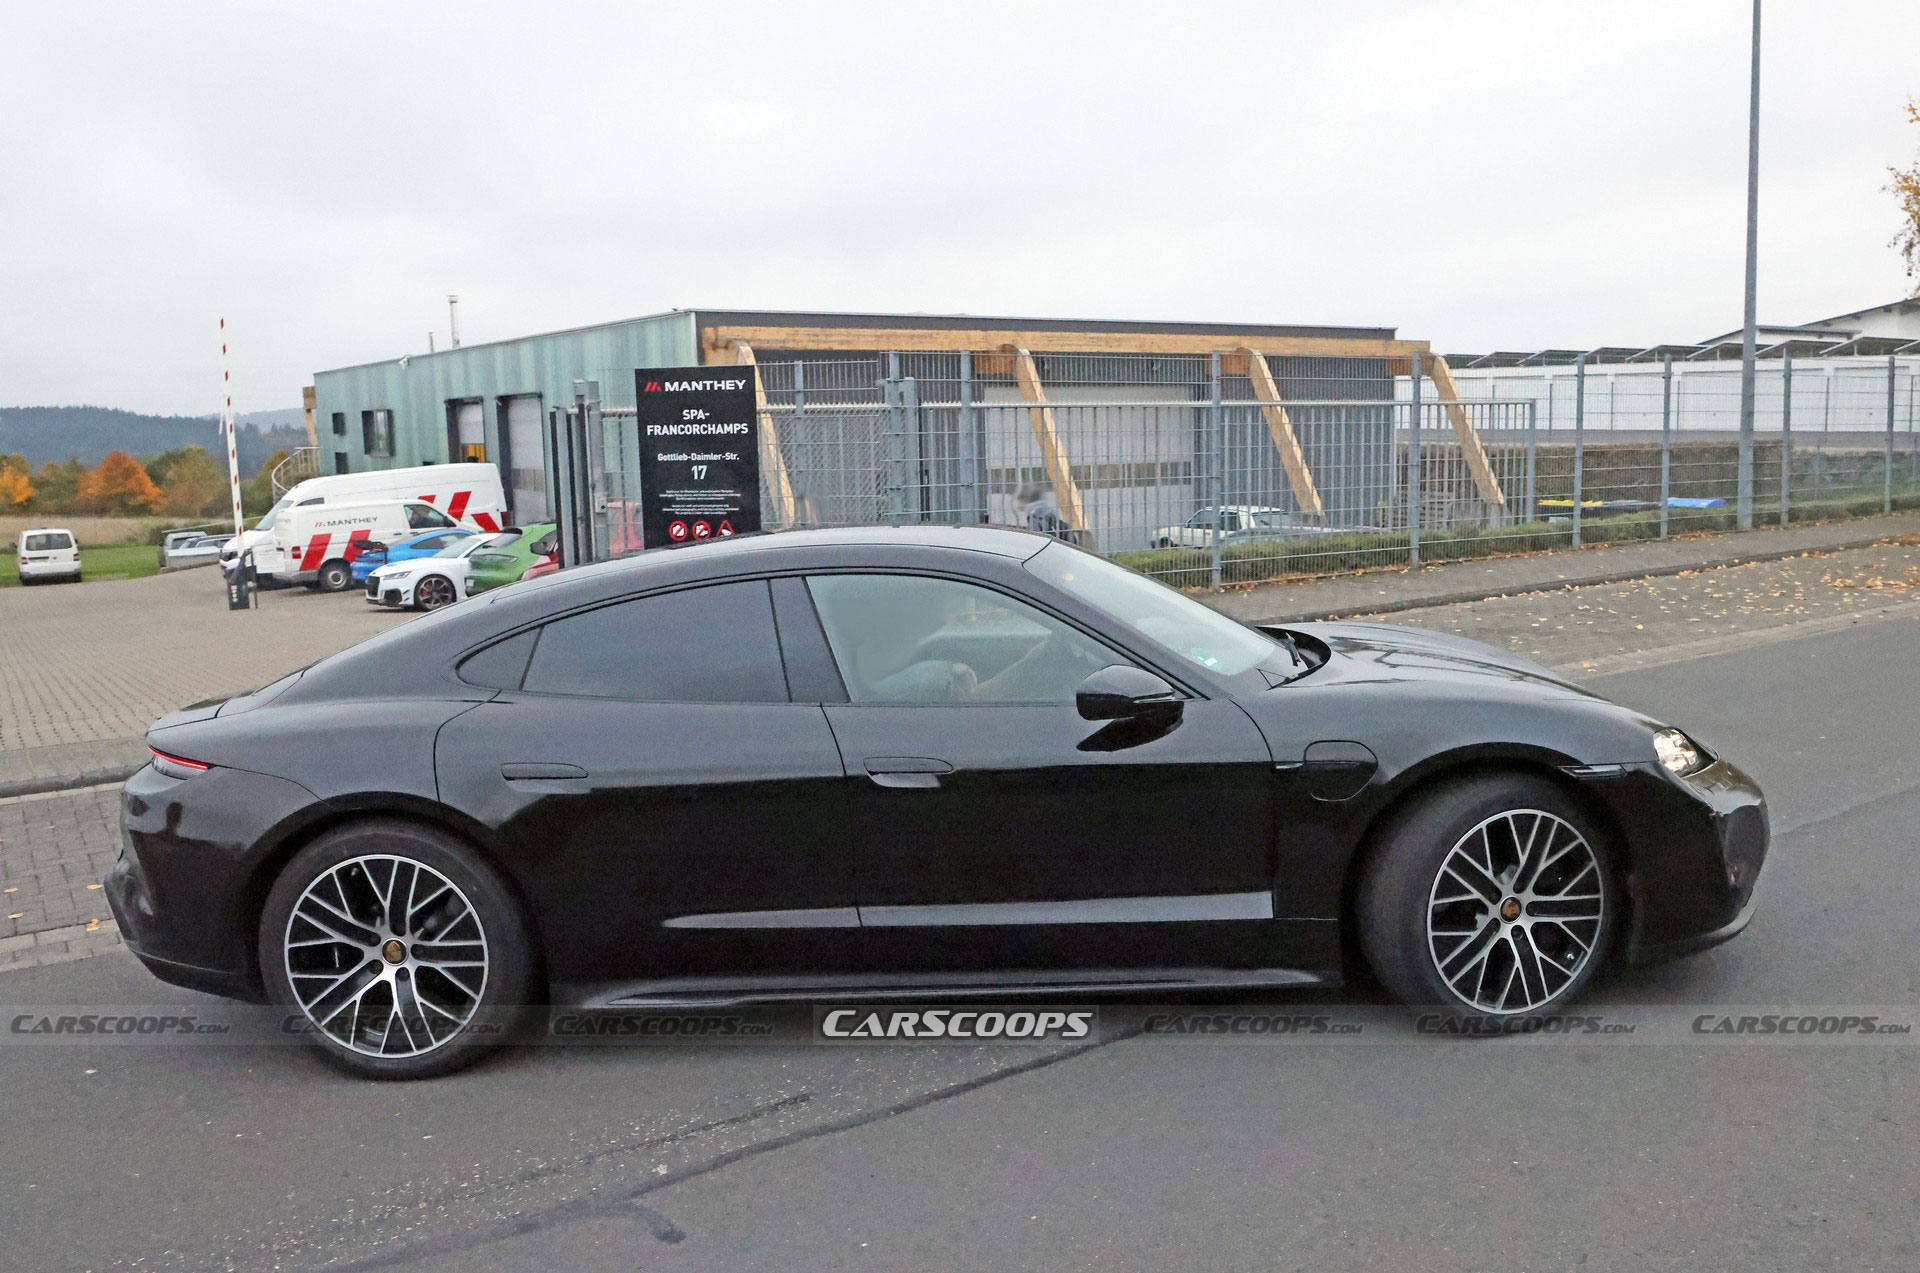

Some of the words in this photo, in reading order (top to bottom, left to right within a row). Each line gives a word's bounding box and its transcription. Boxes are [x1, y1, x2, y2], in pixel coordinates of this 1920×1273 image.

[664, 379, 747, 392] MANTHEY
[682, 409, 710, 420] SPA-
[646, 423, 749, 436] FRANCORCHAMPS
[657, 452, 740, 461] Gottlieb-Daimler-Str.
[691, 465, 708, 480] 17
[327, 516, 378, 527] MANTHEY
